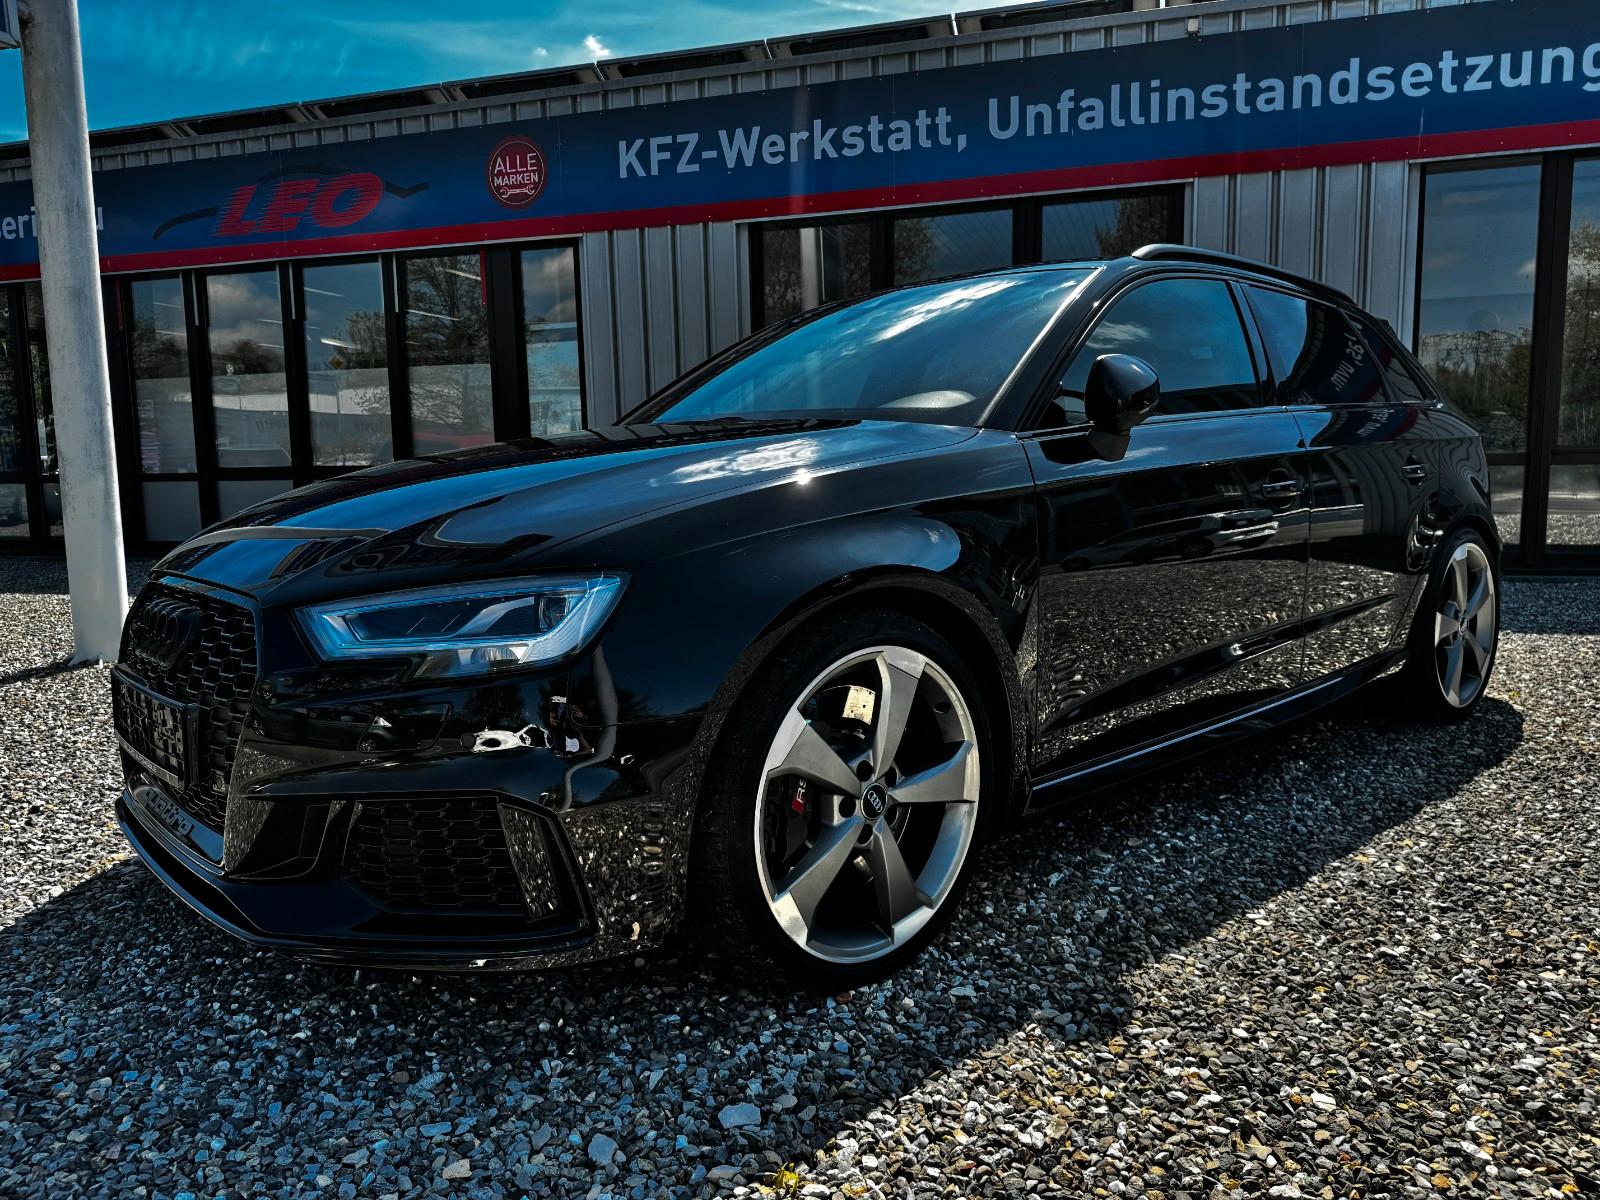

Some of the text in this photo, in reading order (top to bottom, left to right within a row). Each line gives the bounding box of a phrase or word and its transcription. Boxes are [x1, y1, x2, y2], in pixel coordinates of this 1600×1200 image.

[618, 42, 1600, 179] KFZ-Werkstatt, Unfallinstandsetzung
[494, 152, 537, 174] ALLE
[494, 172, 539, 187] MARKEN
[209, 171, 384, 238] LEO
